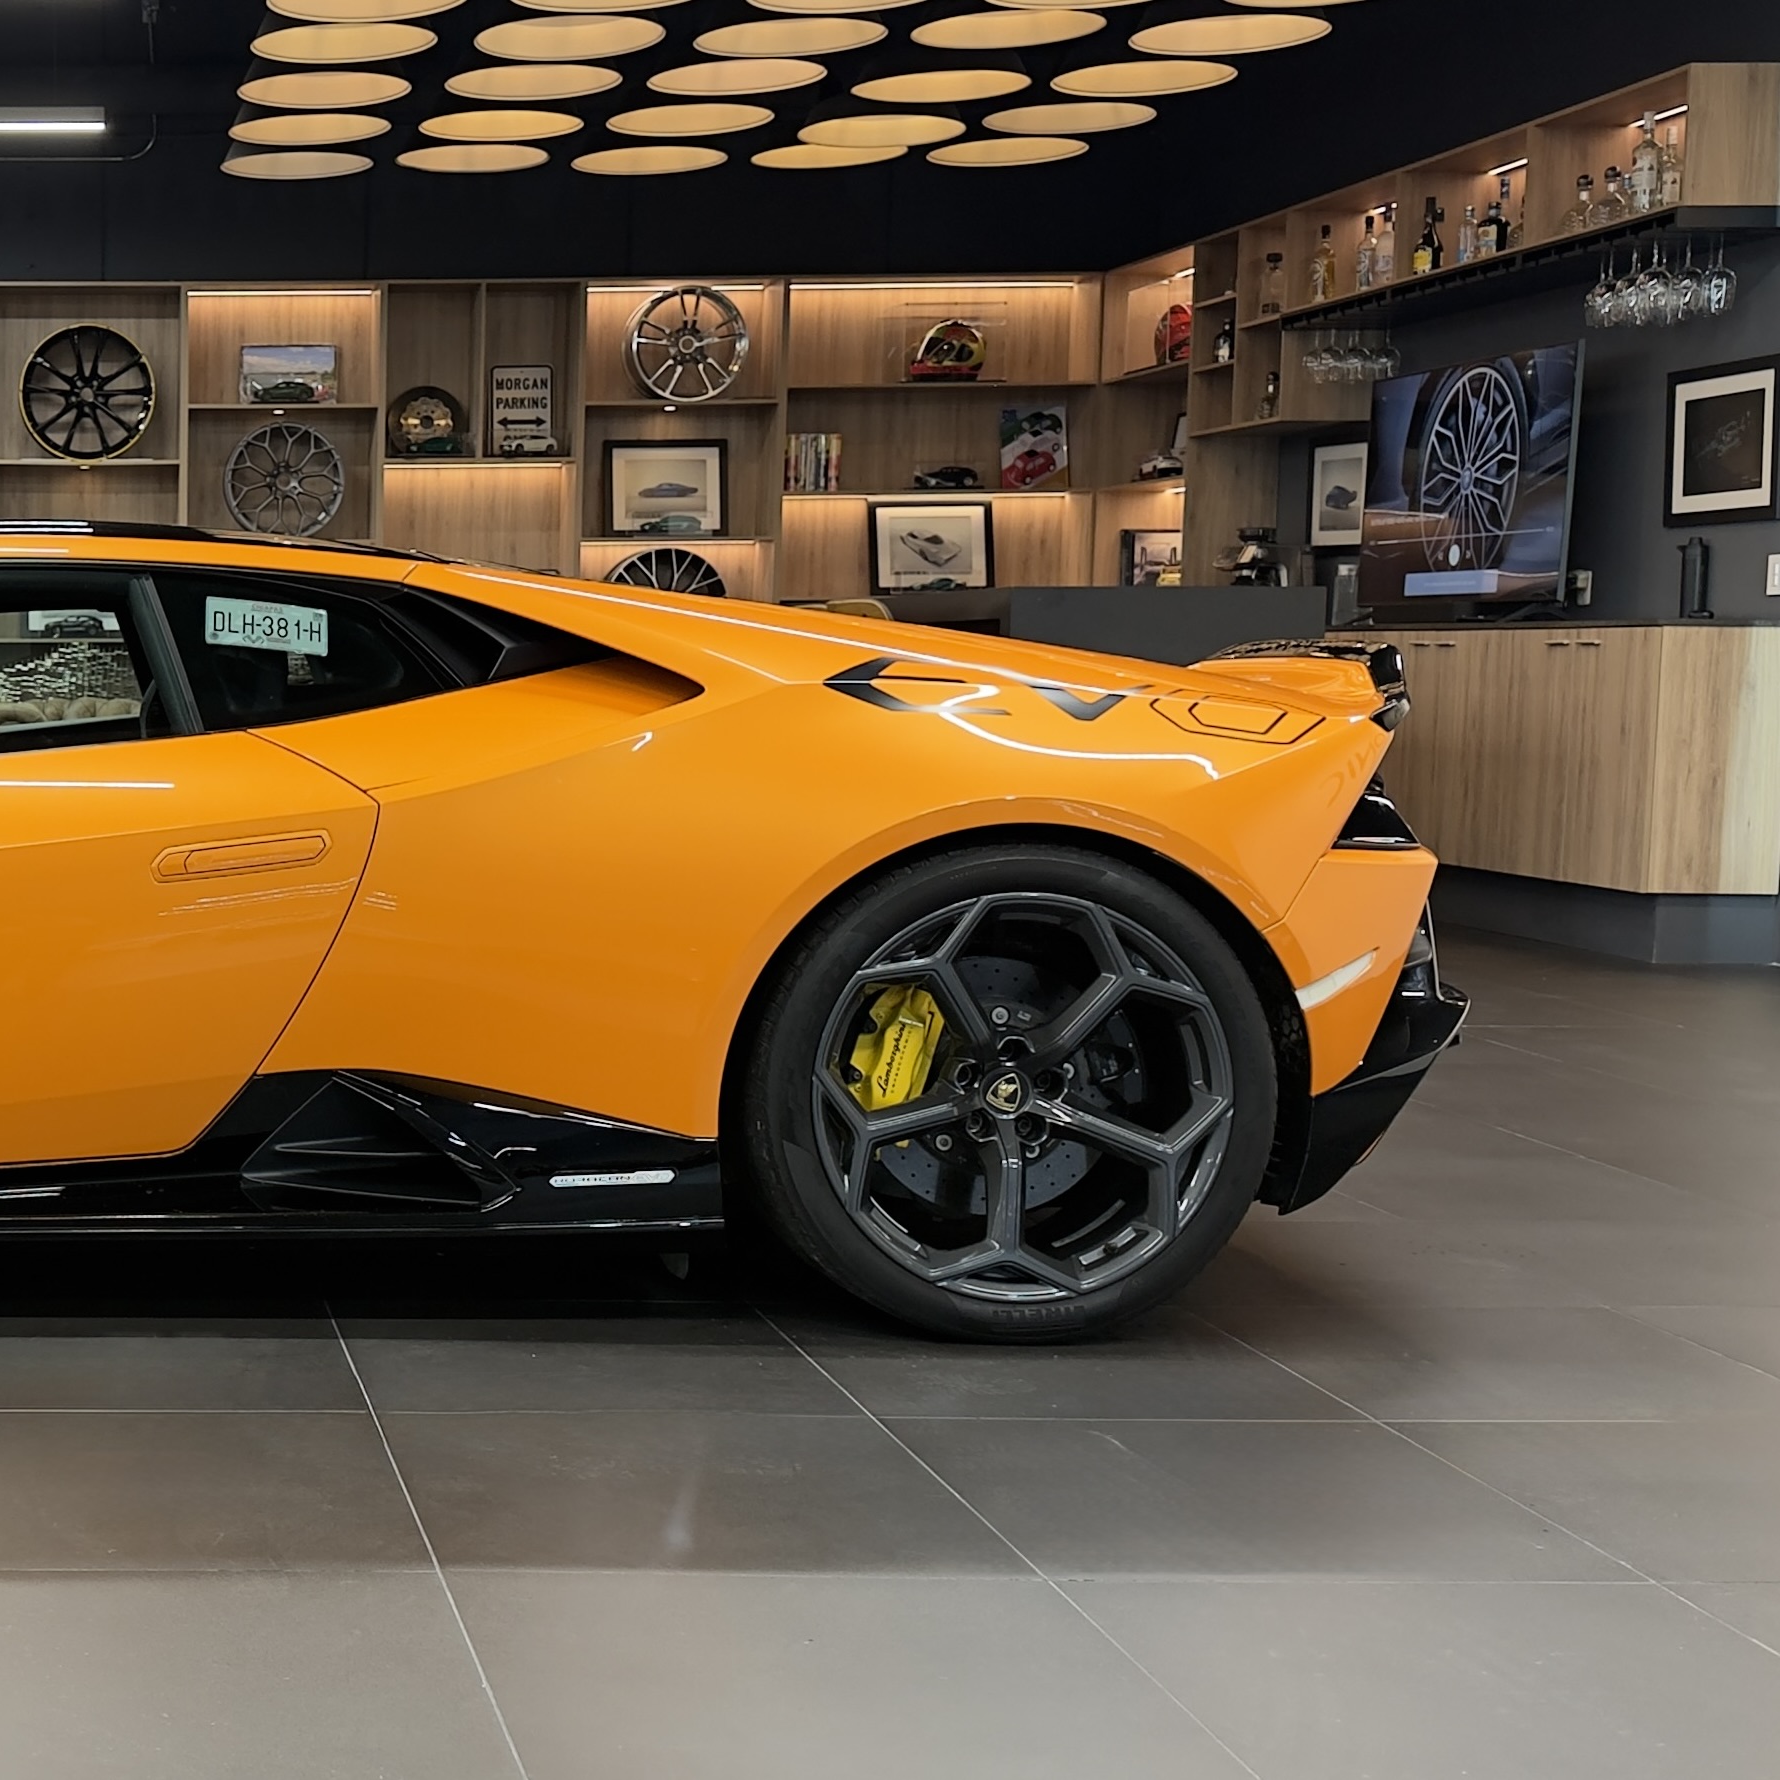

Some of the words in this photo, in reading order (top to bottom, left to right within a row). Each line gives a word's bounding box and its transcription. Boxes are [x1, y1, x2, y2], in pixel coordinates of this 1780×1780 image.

[495, 378, 548, 391] MORGAN
[495, 397, 548, 410] PARKING
[213, 610, 321, 642] DLH-381-H
